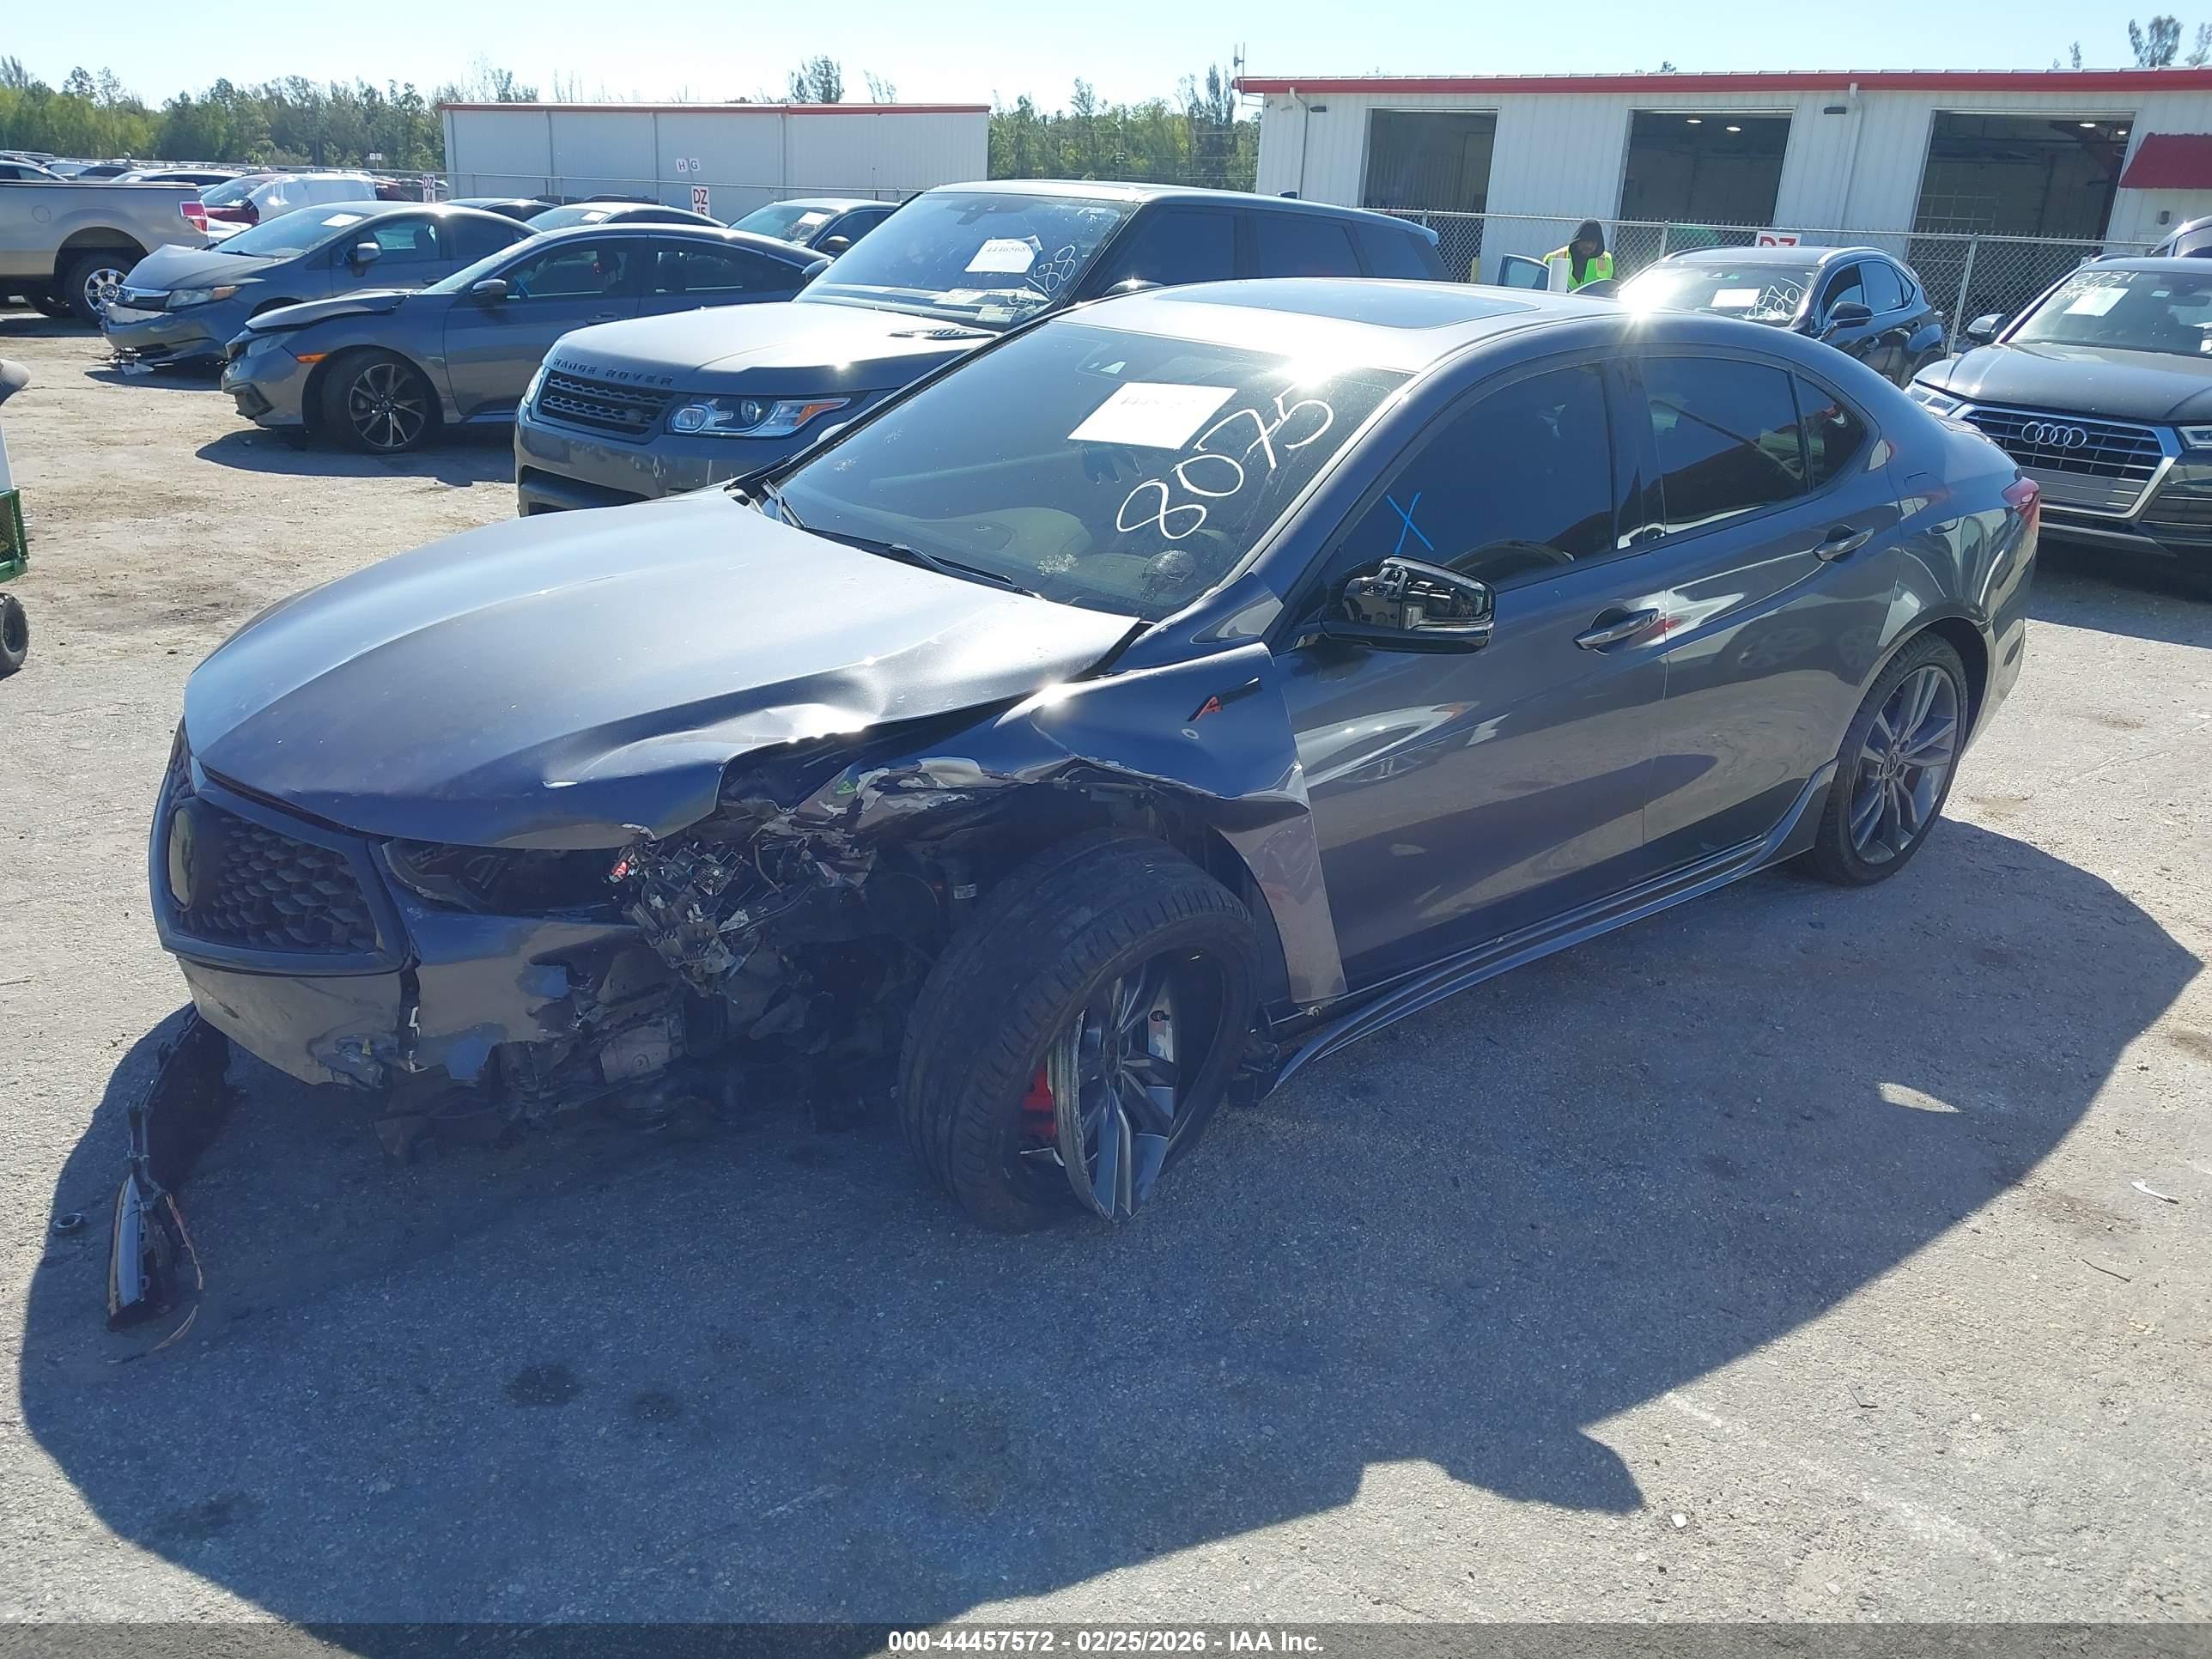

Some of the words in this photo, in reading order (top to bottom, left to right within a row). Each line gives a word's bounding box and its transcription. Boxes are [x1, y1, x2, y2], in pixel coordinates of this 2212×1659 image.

[678, 161, 686, 170] H
[690, 161, 698, 169] G
[424, 176, 434, 190] DZ
[693, 189, 708, 205] DZ
[553, 357, 599, 375] RANGE
[605, 368, 674, 386] ROVER
[1116, 384, 1334, 540] 8075
